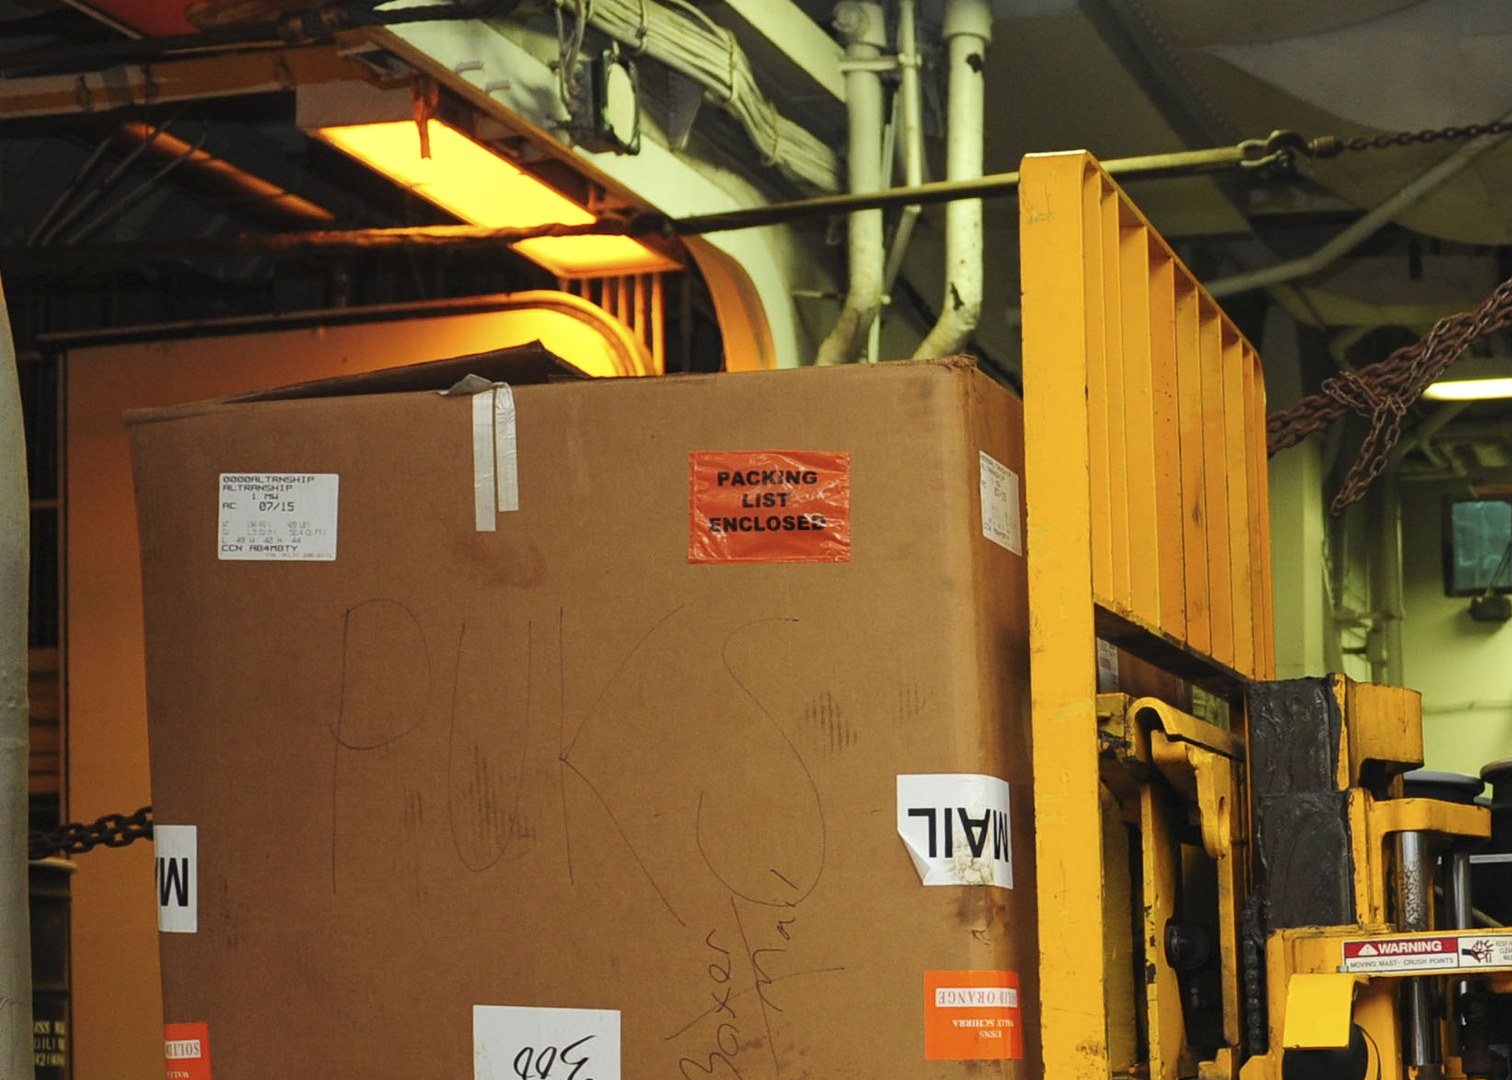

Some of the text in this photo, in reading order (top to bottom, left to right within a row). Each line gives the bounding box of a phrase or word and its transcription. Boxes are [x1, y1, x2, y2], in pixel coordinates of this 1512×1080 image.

[717, 470, 818, 487] PACKING
[259, 501, 295, 511] 07/15
[741, 492, 790, 508] LIST
[708, 515, 827, 532] ENCLOSED
[908, 807, 1010, 862] MAIL
[156, 857, 189, 907] M
[1378, 940, 1443, 954] WARNING
